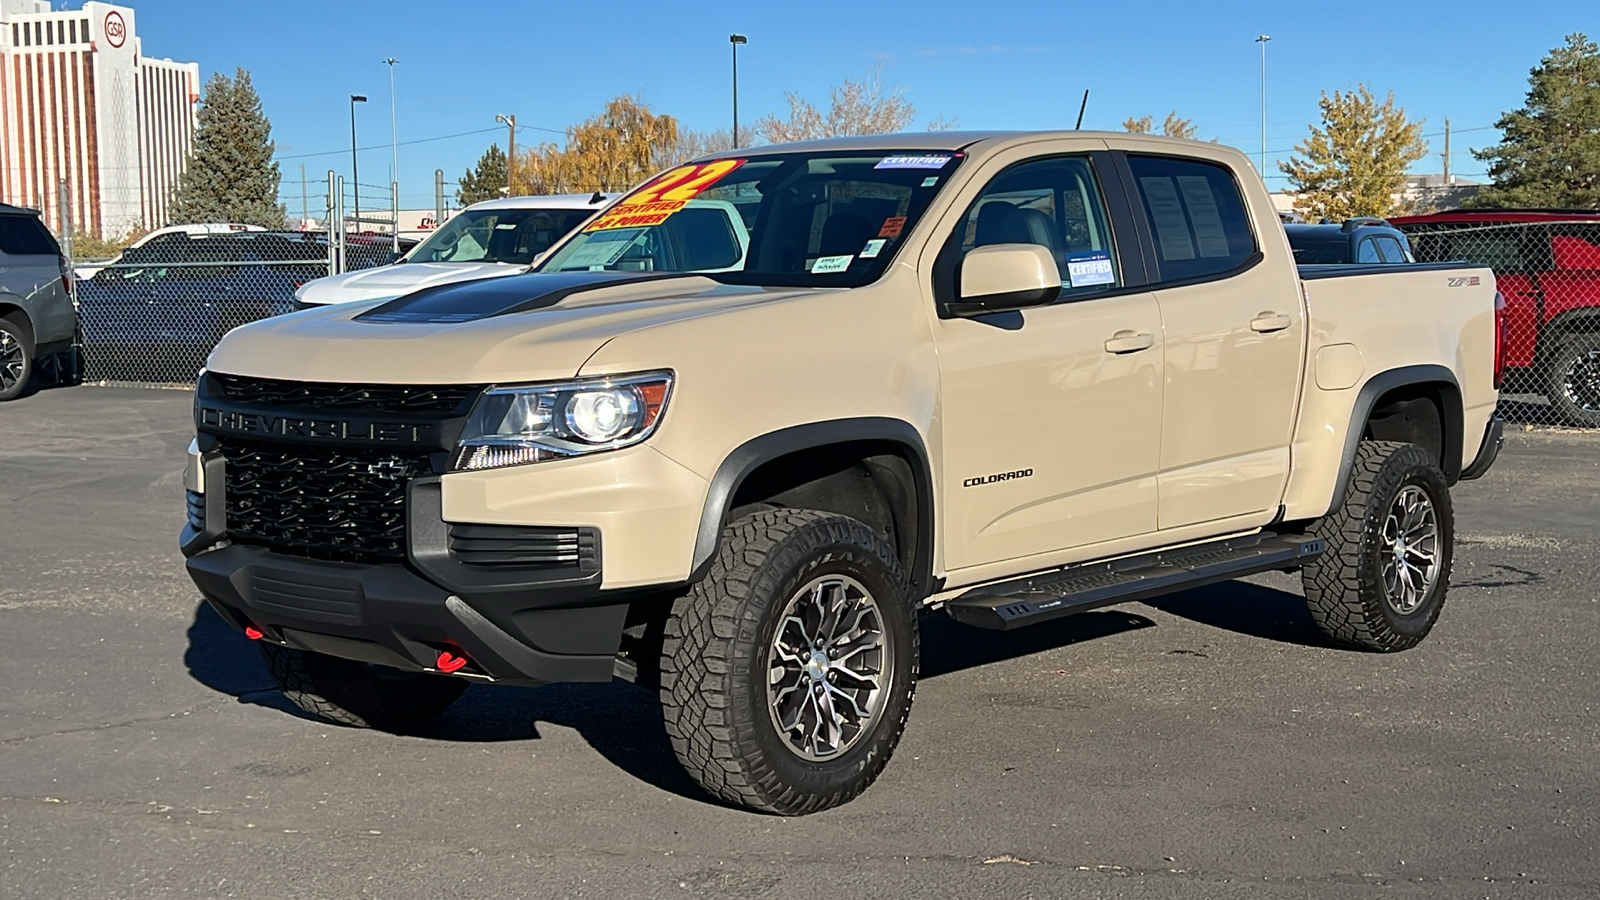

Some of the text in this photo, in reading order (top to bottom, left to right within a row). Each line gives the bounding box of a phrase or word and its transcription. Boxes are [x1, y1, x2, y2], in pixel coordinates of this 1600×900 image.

[107, 21, 123, 38] GSR
[621, 160, 738, 205] 22
[605, 201, 686, 217] CERTIFIED
[610, 213, 669, 227] POWER
[1071, 262, 1110, 276] CERTIFIED
[1447, 276, 1480, 287] ZR2
[201, 407, 433, 443] CHEVROLET
[963, 468, 1033, 488] COLORADO
